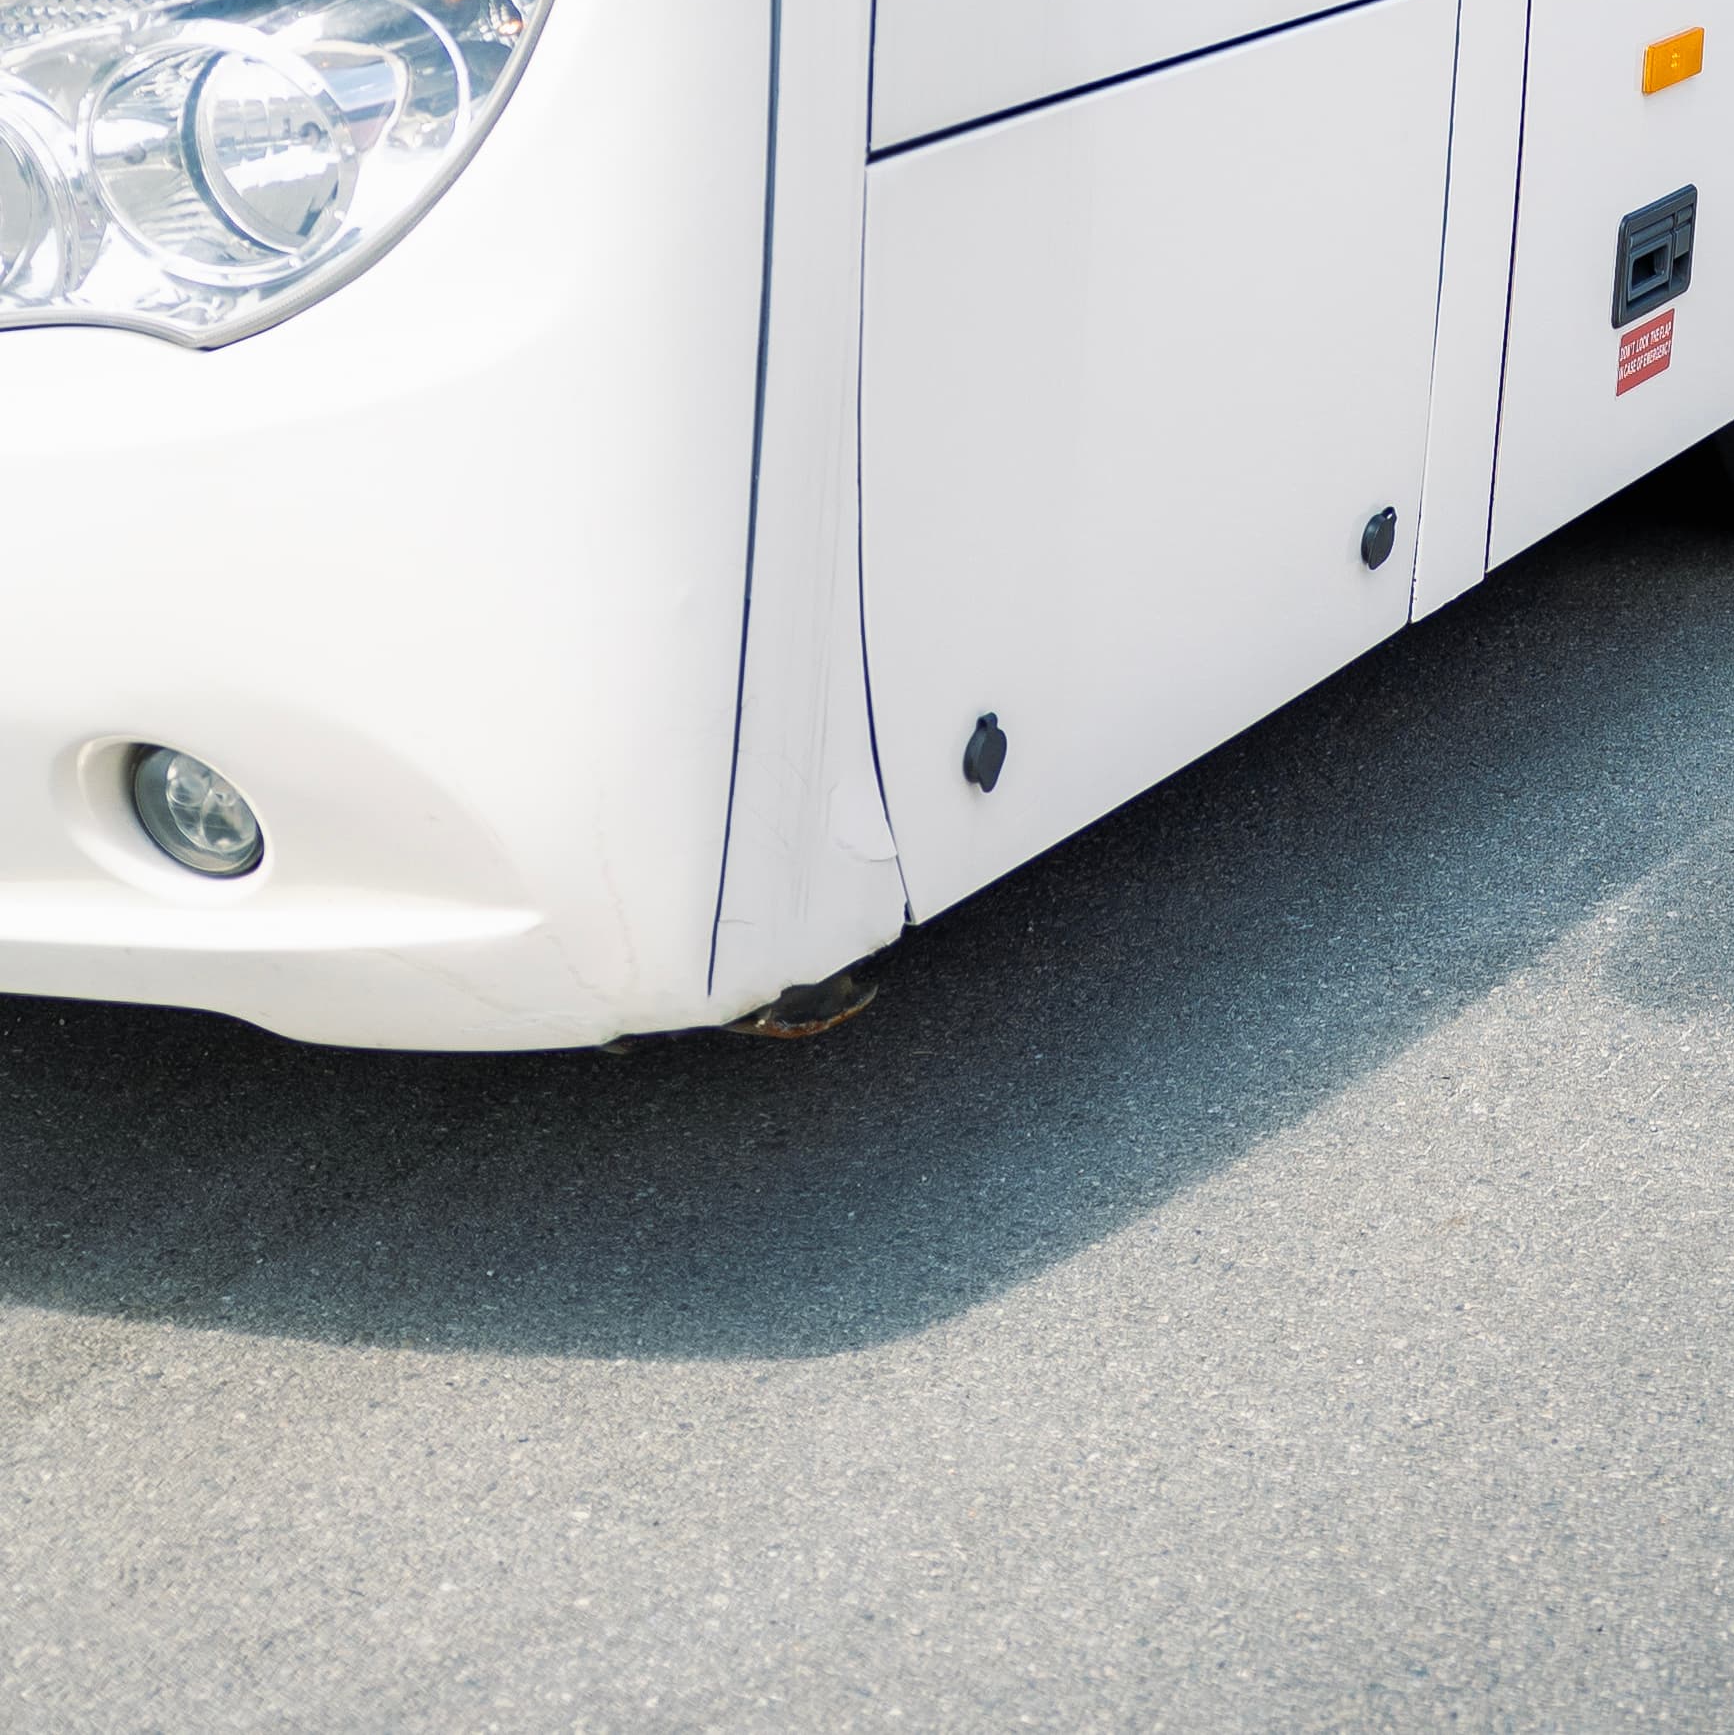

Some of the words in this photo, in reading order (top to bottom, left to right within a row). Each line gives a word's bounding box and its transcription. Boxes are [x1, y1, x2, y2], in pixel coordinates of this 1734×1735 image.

[1618, 366, 1625, 380] IN
[1624, 359, 1637, 379] CASE
[1636, 355, 1644, 372] OF
[1643, 340, 1672, 368] EMERGENCY
[1619, 340, 1636, 362] DON'T
[1635, 333, 1650, 353] LOCK
[1650, 327, 1660, 345] THE
[1659, 321, 1672, 339] FLAP
